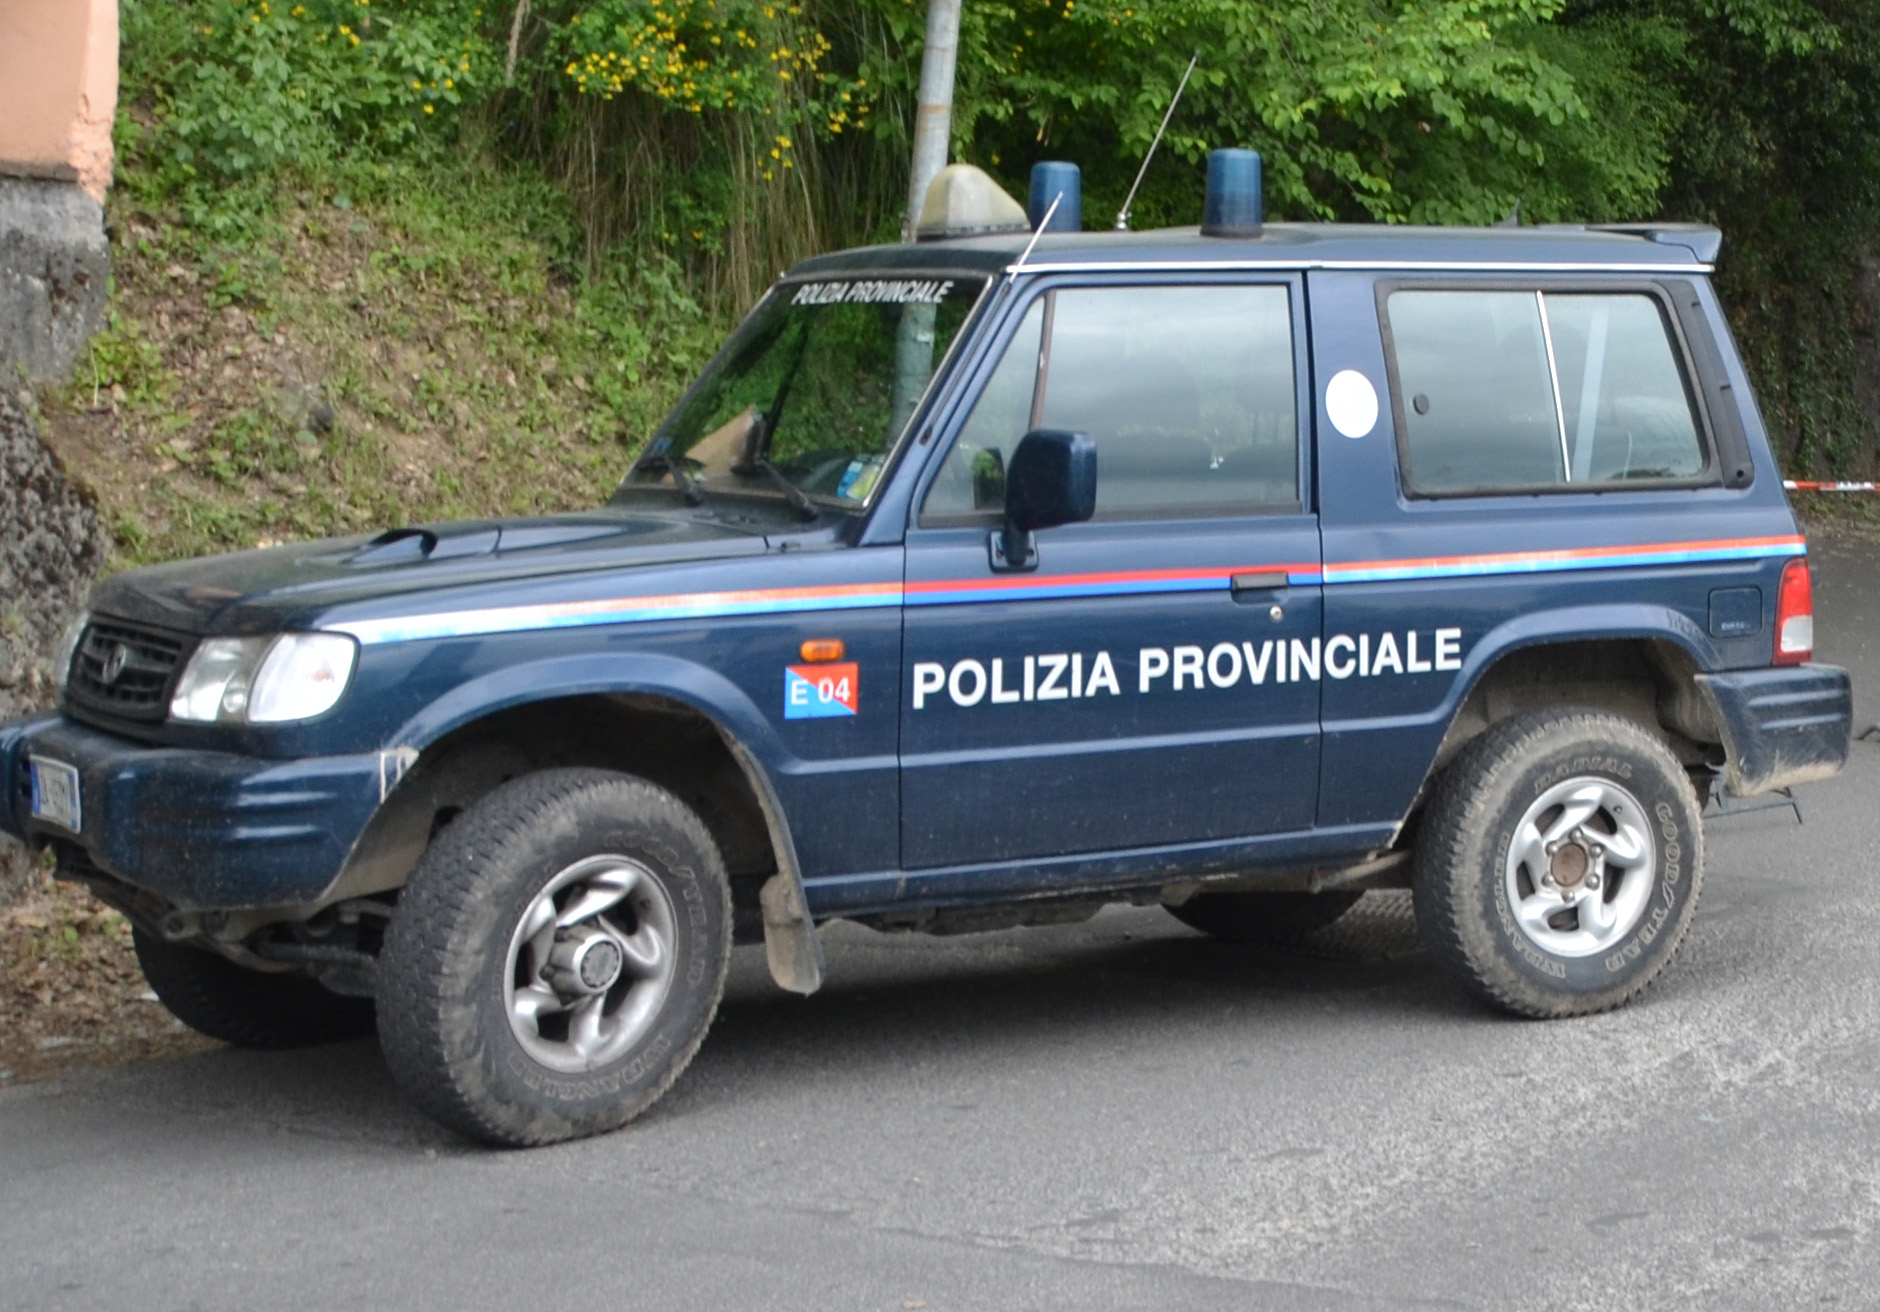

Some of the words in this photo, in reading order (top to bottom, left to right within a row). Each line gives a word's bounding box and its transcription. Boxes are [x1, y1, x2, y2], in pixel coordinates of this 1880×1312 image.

[790, 679, 808, 705] E
[818, 677, 851, 704] 04
[912, 651, 1121, 709] POLIZIA
[1138, 628, 1462, 693] PROVINCIALE
